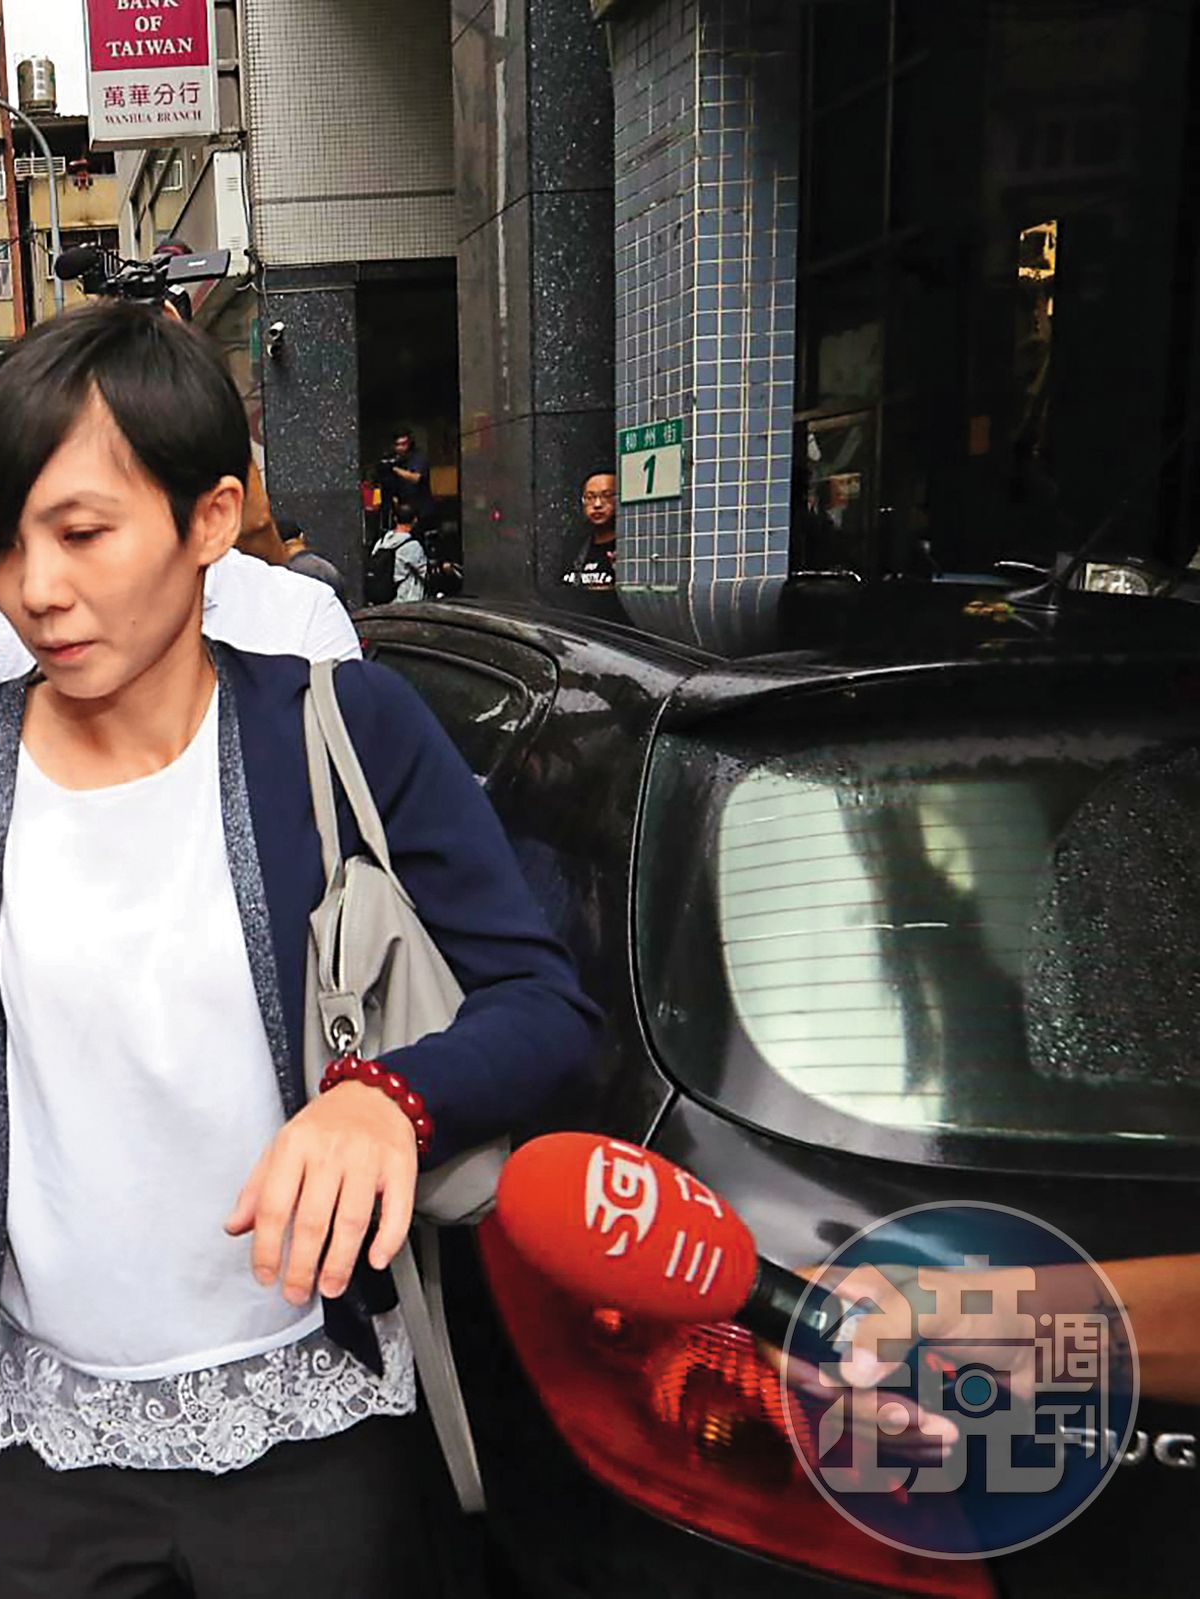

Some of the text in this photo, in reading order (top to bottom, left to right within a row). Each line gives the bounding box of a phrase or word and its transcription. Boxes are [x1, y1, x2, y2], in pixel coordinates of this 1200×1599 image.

[135, 16, 162, 32] OF
[106, 37, 192, 57] TAIWAN
[103, 82, 201, 108] 萬華分行
[157, 110, 201, 122] BRANCH
[643, 454, 656, 494] 1
